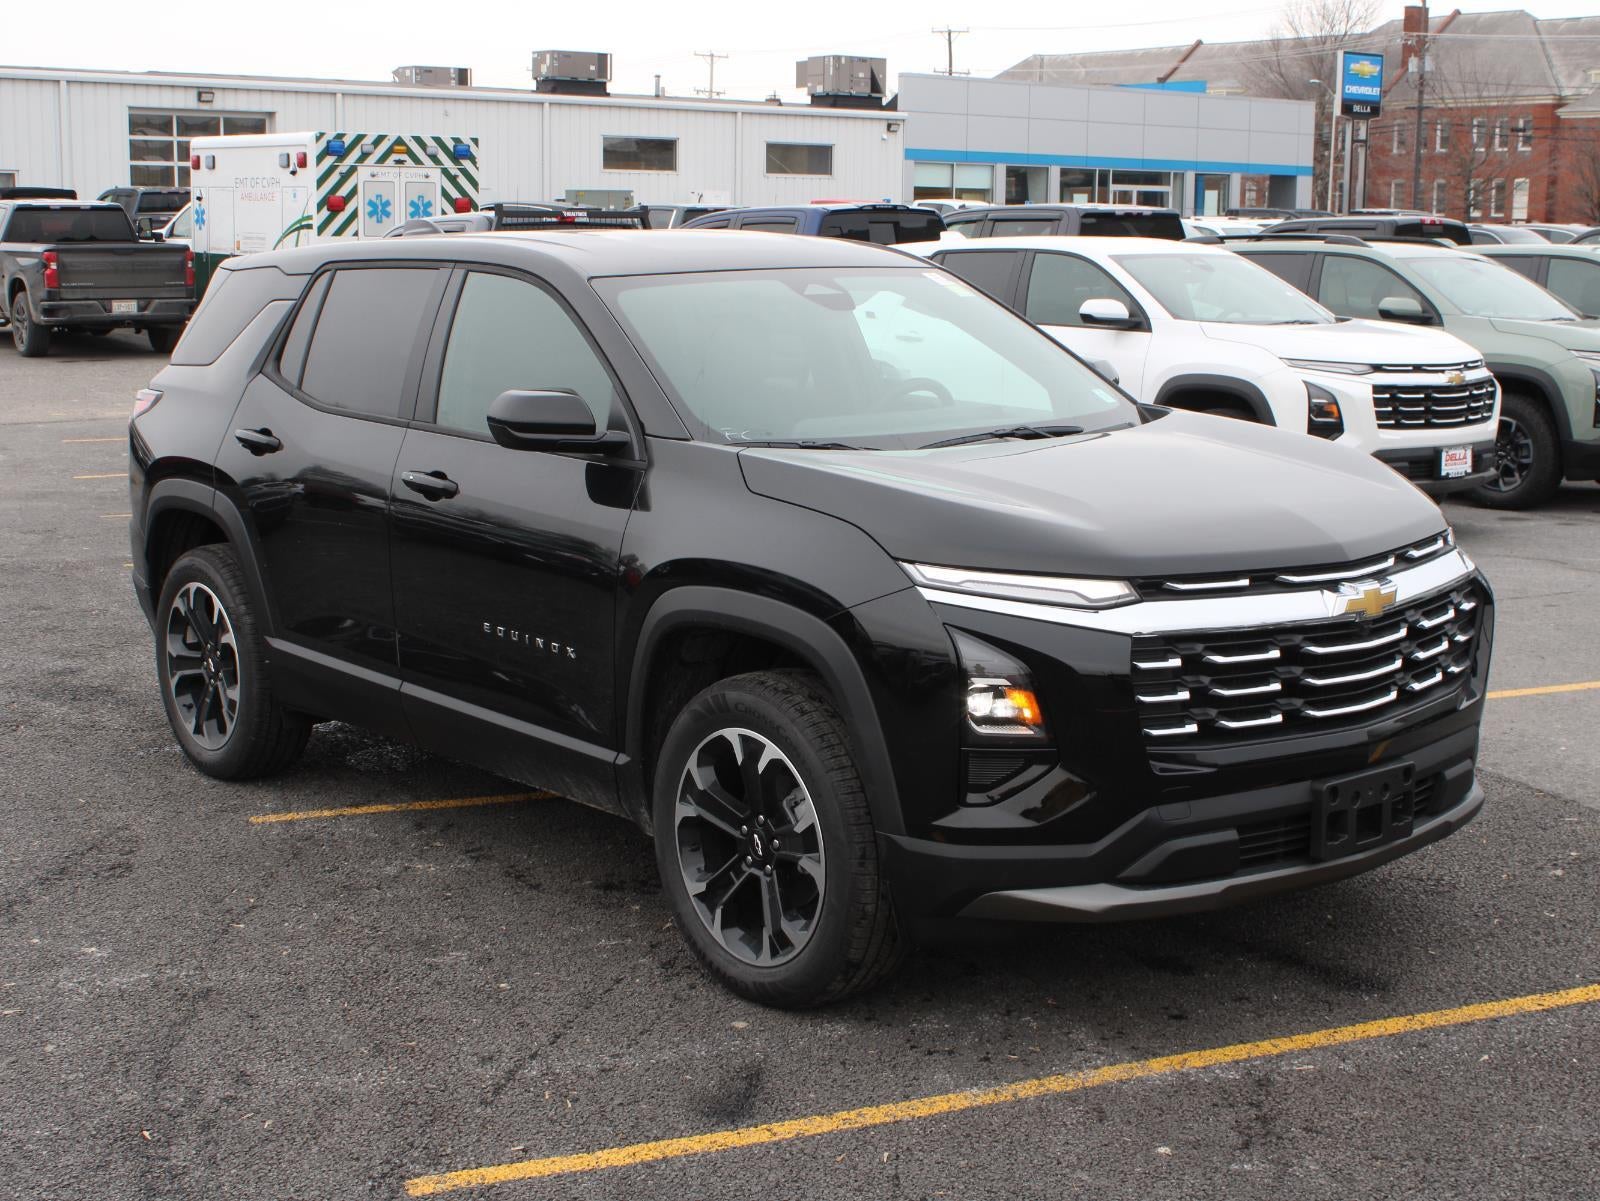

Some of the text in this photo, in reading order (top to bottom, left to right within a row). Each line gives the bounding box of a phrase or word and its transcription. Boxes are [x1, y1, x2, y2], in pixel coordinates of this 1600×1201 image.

[1345, 85, 1380, 95] CHEVROLET
[1353, 104, 1370, 112] DELLA
[234, 177, 248, 189] EMT
[250, 177, 260, 189] OF
[240, 192, 276, 202] AMBULANCE
[1445, 450, 1467, 462] DELLA
[483, 622, 577, 660] EQUINOX
